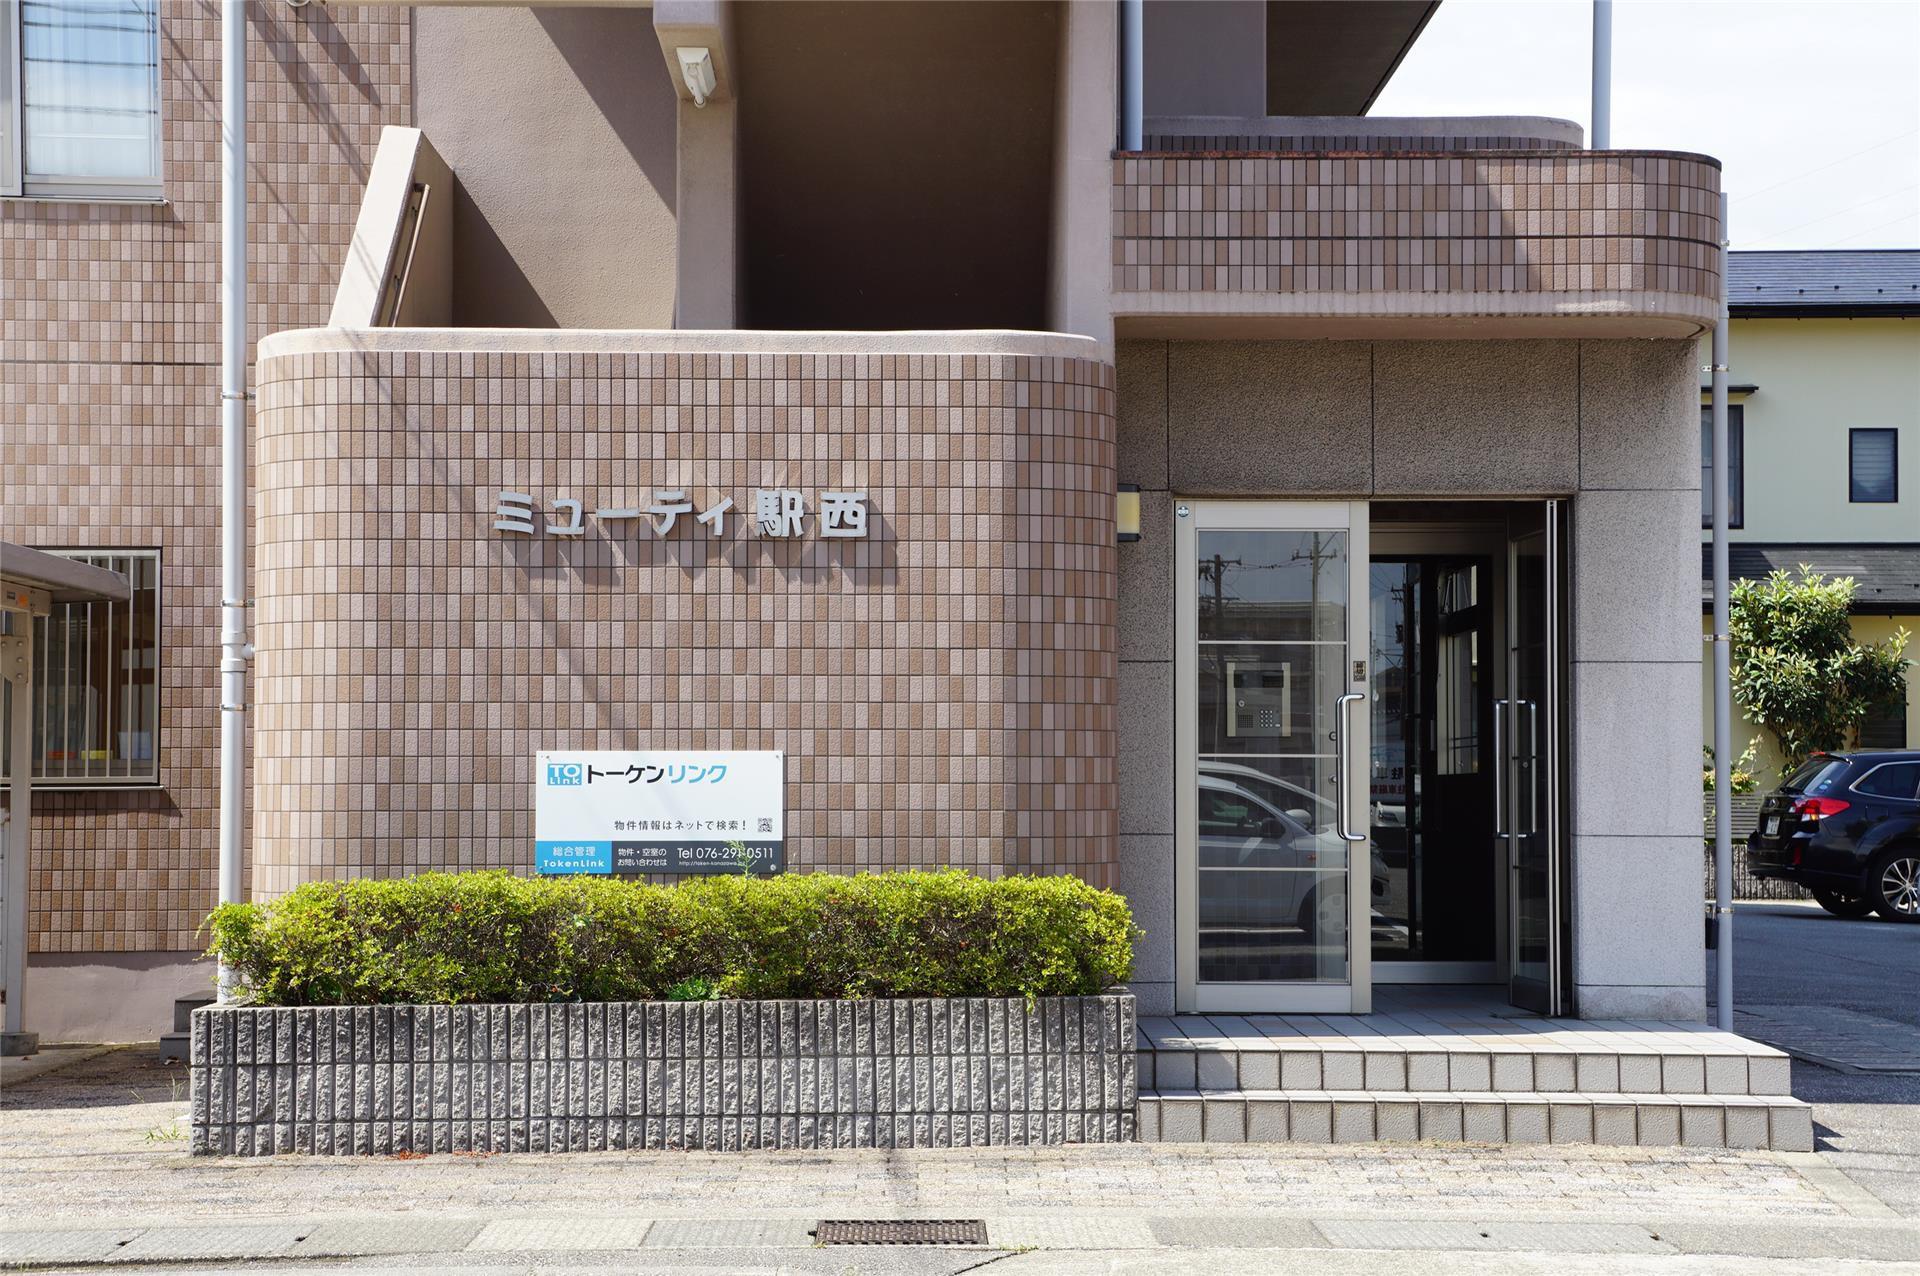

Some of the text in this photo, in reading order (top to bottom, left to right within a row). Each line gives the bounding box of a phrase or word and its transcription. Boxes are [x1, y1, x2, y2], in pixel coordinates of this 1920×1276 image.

[493, 490, 868, 538] ミューティ駅西
[550, 764, 581, 777] TO
[587, 764, 727, 784] トーケンリンク
[553, 846, 596, 857] 総合管理
[677, 847, 773, 859] Tel 076-2910511
[543, 860, 605, 868] TokenLink
[617, 858, 667, 867] お問い合わせは
